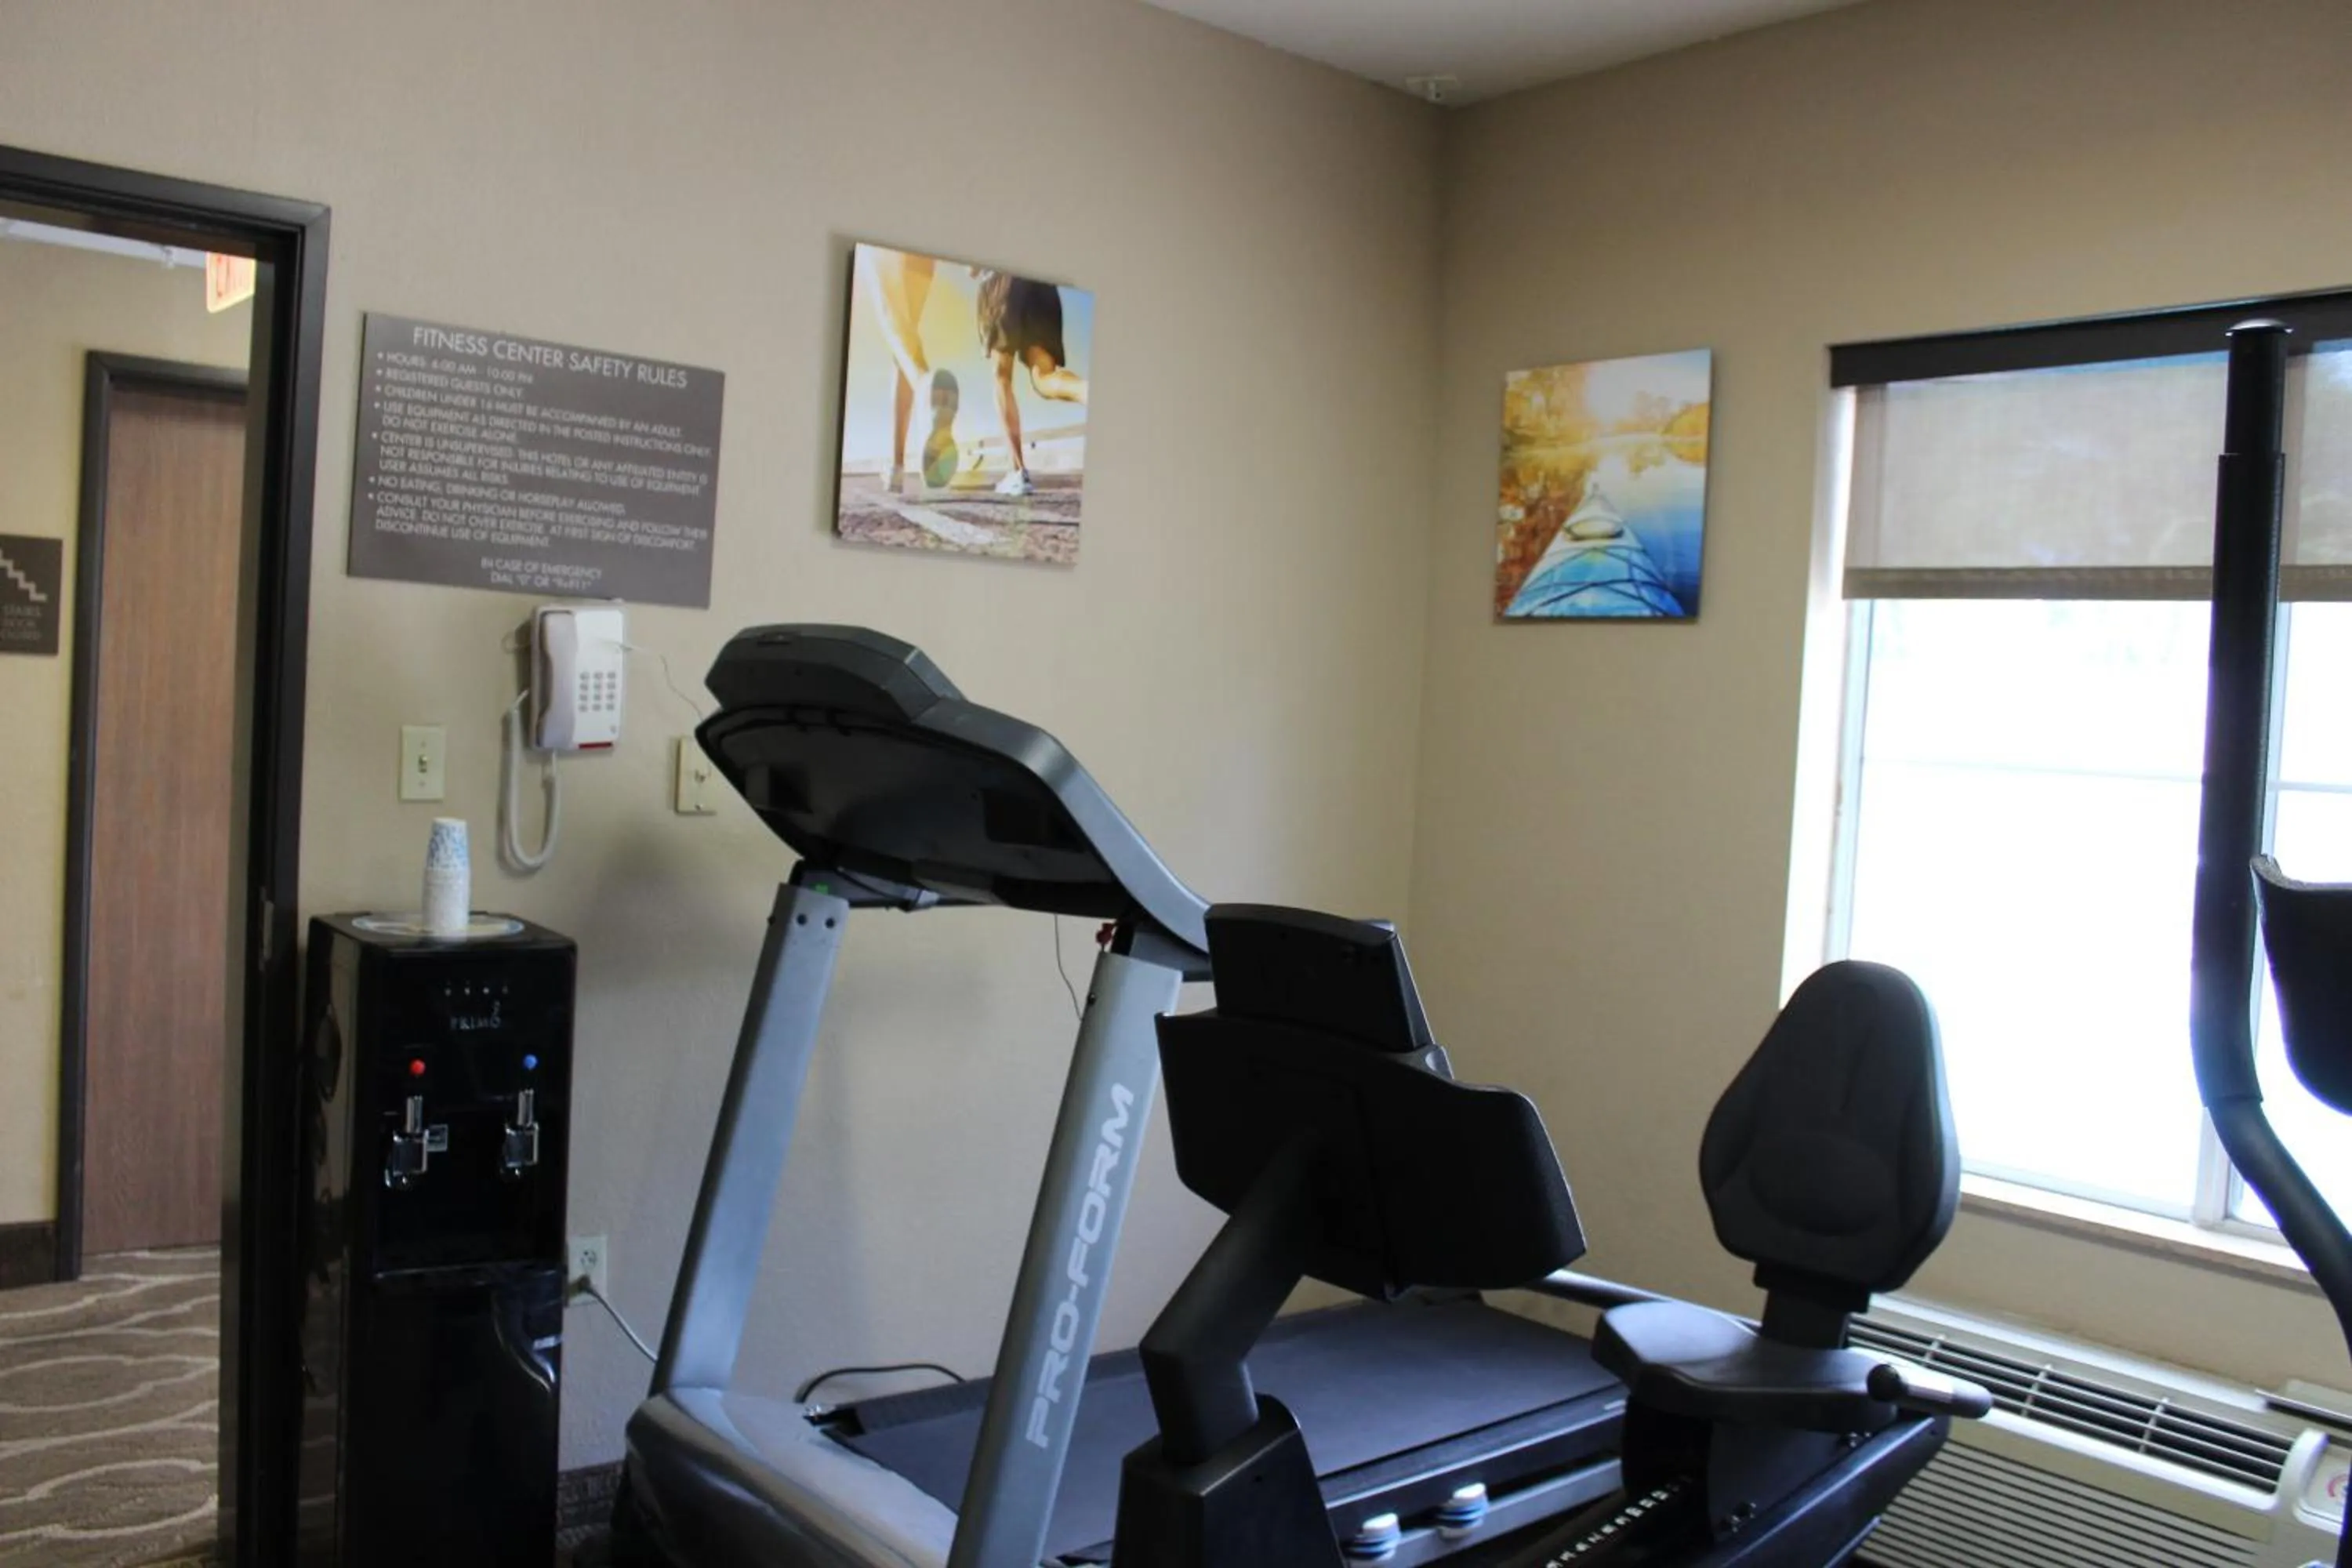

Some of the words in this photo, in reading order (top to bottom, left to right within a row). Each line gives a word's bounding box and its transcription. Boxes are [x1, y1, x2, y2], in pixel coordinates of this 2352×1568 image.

[413, 326, 488, 356] FITNESS
[493, 339, 563, 368] CENTER
[570, 352, 631, 379] SAFETY
[638, 364, 688, 388] RULES
[450, 377, 491, 394] GUESTS
[384, 384, 437, 403] CHILDREN
[633, 421, 649, 433] AN
[383, 415, 401, 428] DO
[403, 417, 426, 431] NOT
[430, 421, 477, 438] EXERCISE
[383, 401, 405, 415] USE
[407, 405, 470, 424] EQUIPMENT
[489, 416, 537, 434] DIRECTED
[539, 423, 550, 435] IN
[553, 425, 571, 437] THE
[574, 428, 610, 443] POSTED
[613, 434, 682, 453] INSTRUCTIONS
[380, 445, 405, 459] NOT
[408, 448, 474, 468] RESPONSIBLE
[477, 457, 498, 471] FOR
[546, 466, 592, 483] RELATING
[594, 472, 607, 485] TO
[609, 474, 628, 487] USE
[630, 477, 644, 489] OF
[381, 430, 423, 448] CENTER
[425, 437, 434, 449] IS
[574, 456, 589, 469] OR
[591, 459, 614, 473] ANY
[378, 474, 398, 489] NO
[446, 483, 498, 501] DRINKING
[500, 489, 515, 503] OR
[462, 469, 478, 481] ALL
[376, 492, 427, 508] CONSULT
[430, 497, 460, 511] YOUR
[463, 501, 517, 518] PHYSICIAN
[617, 519, 640, 532] AND
[422, 510, 439, 524] DO
[442, 512, 465, 526] NOT
[452, 527, 470, 540] USE
[473, 529, 488, 542] OF
[481, 557, 493, 569] IN
[495, 558, 522, 572] CASE
[524, 561, 539, 573] OF
[1025, 1083, 1134, 1448] PRO-FORM
